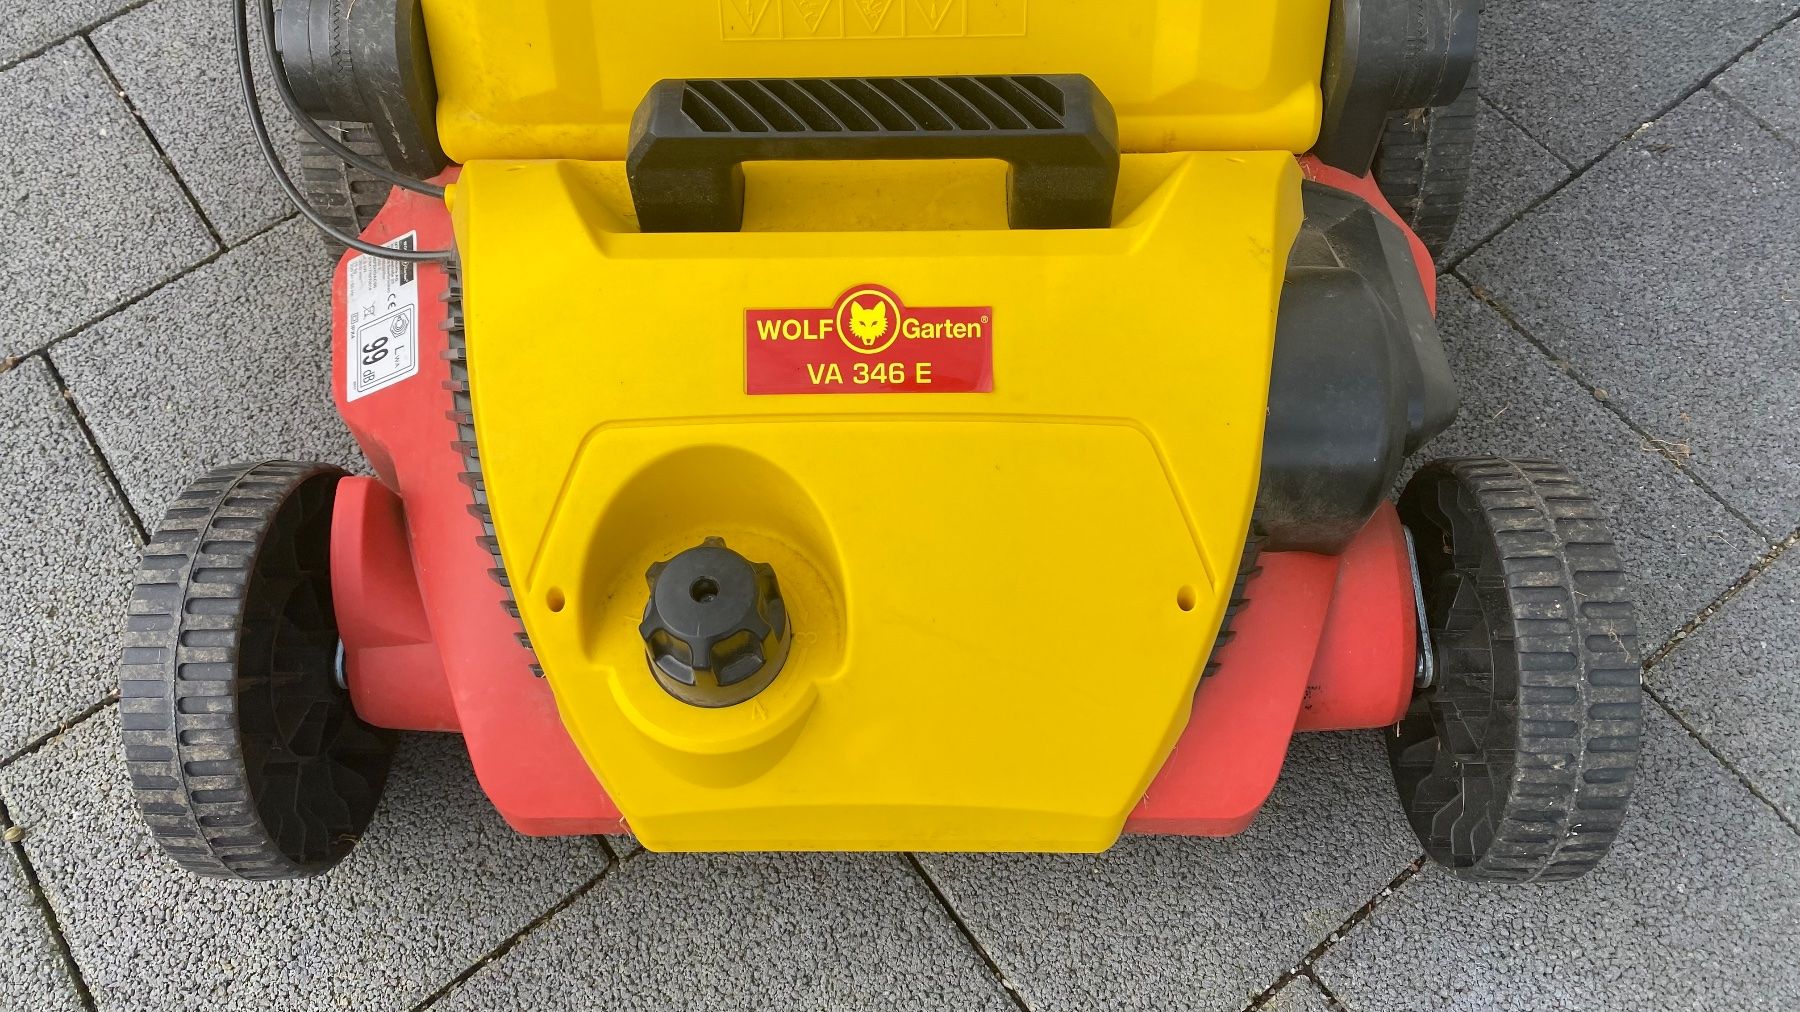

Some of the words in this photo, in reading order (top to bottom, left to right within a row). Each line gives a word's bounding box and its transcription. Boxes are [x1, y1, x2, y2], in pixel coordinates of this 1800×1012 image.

[756, 319, 834, 341] WOLF
[362, 336, 389, 366] 99
[363, 369, 376, 384] dB
[806, 363, 844, 385] VA
[852, 362, 905, 384] 346
[915, 362, 932, 384] E
